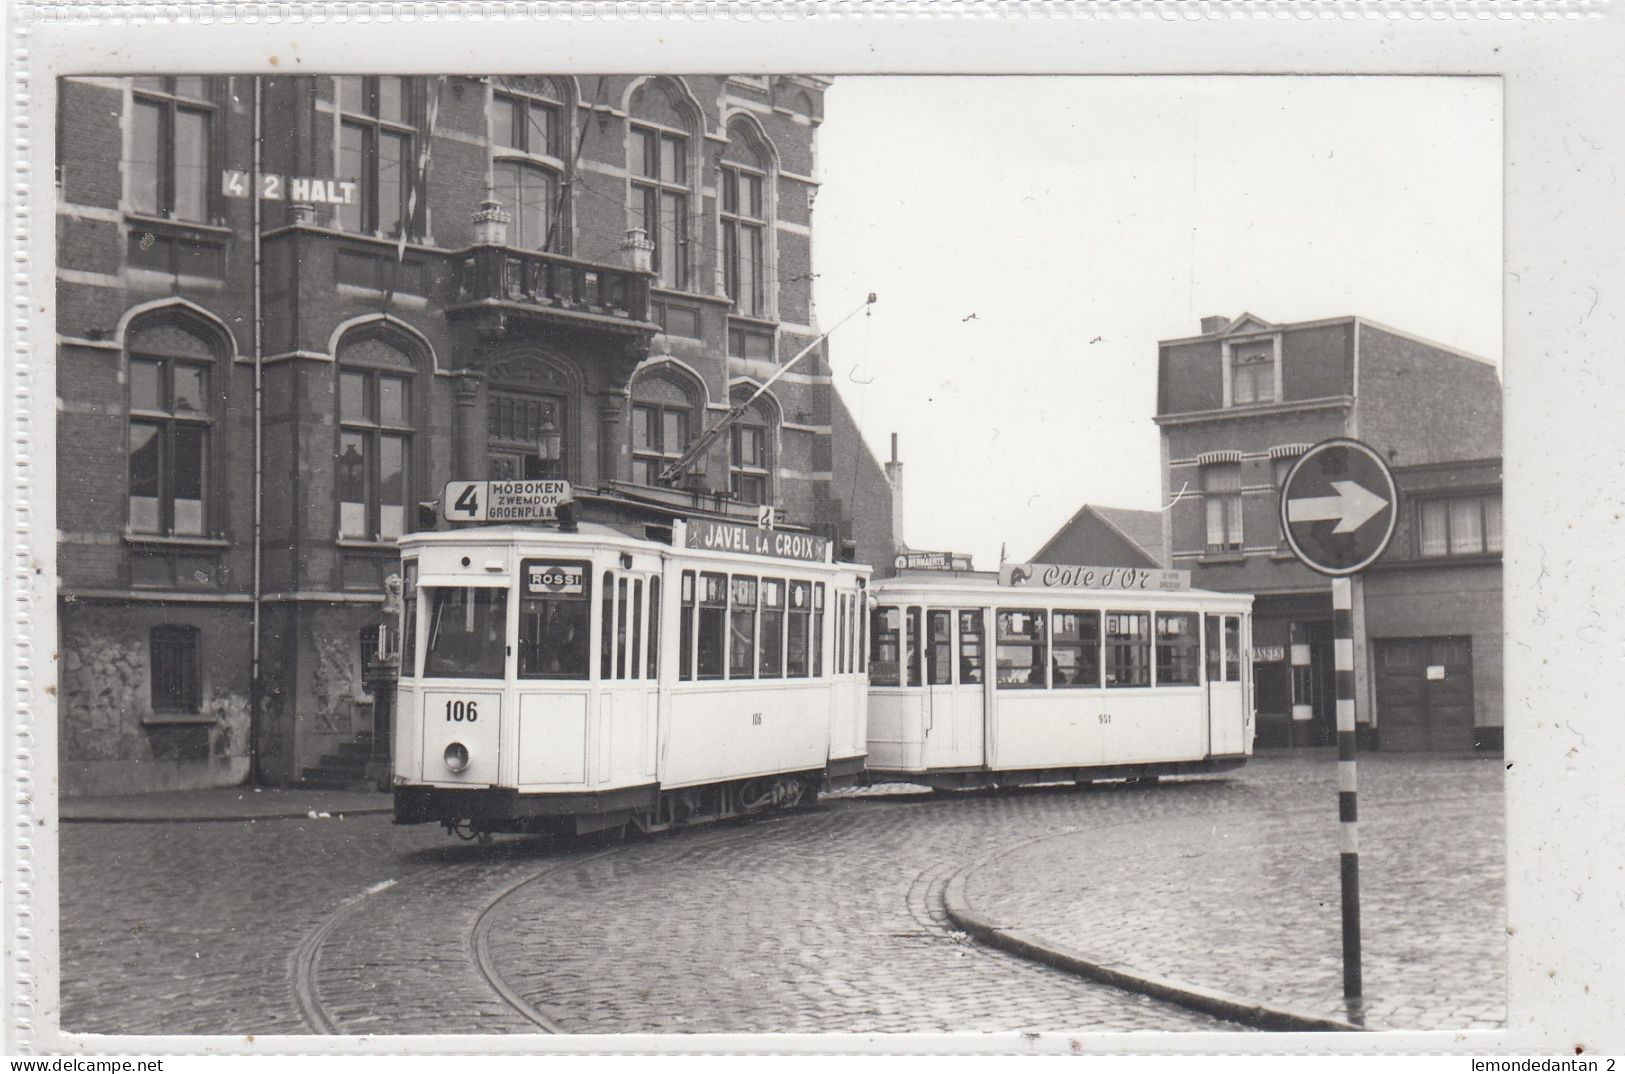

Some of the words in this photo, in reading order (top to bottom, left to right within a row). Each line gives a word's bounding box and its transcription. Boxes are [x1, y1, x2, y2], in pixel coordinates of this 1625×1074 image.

[228, 173, 244, 197] 4
[264, 175, 279, 199] 2
[291, 178, 357, 204] HALT
[493, 483, 564, 495] HOBOKEN
[454, 484, 479, 517] 4
[498, 495, 558, 506] ZWEMDOK
[760, 508, 772, 527] 4
[704, 524, 750, 551] JAVEL
[755, 536, 769, 555] LA
[775, 533, 814, 559] CROIX
[531, 574, 580, 585] ROSSI
[1102, 567, 1151, 589] d'Or
[445, 700, 478, 722] 106
[752, 712, 762, 726] 106
